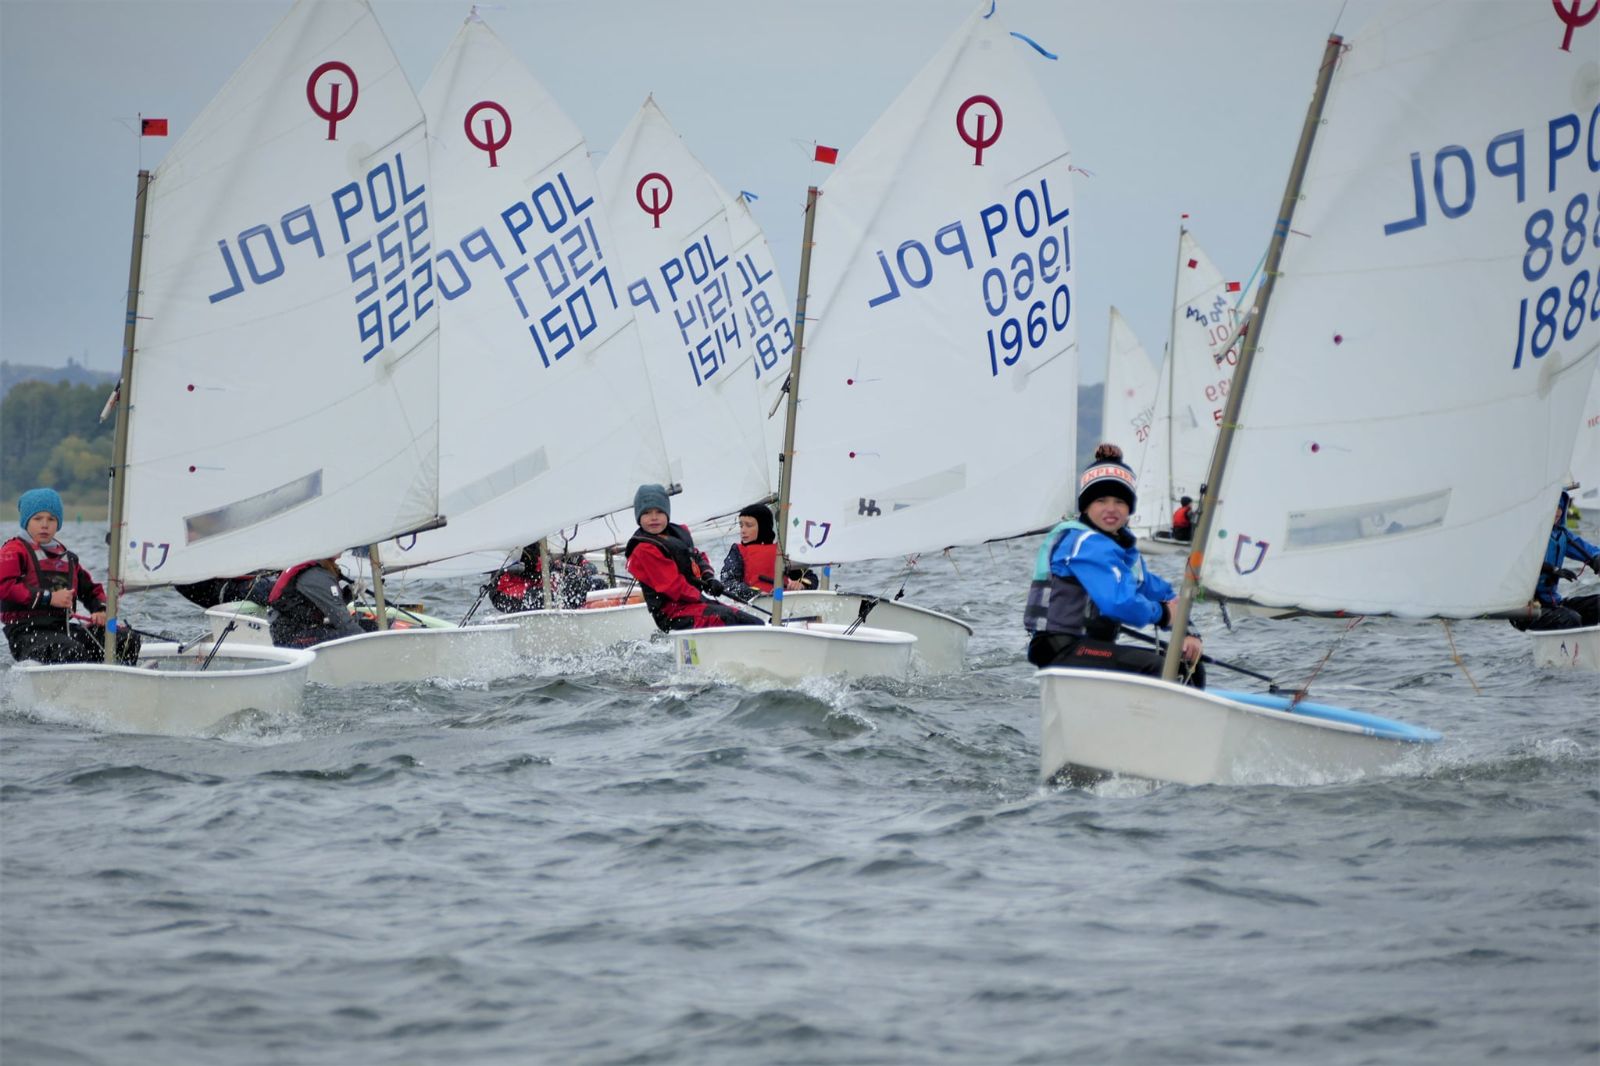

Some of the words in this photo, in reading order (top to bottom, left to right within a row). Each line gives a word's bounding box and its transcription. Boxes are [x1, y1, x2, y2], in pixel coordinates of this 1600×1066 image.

[331, 152, 425, 245] POL
[500, 172, 595, 255] POL
[980, 178, 1070, 258] POL
[357, 258, 434, 364] 922
[660, 234, 729, 302] POL
[528, 266, 618, 369] 1507
[688, 312, 741, 387] 1514
[987, 284, 1071, 377] 1960
